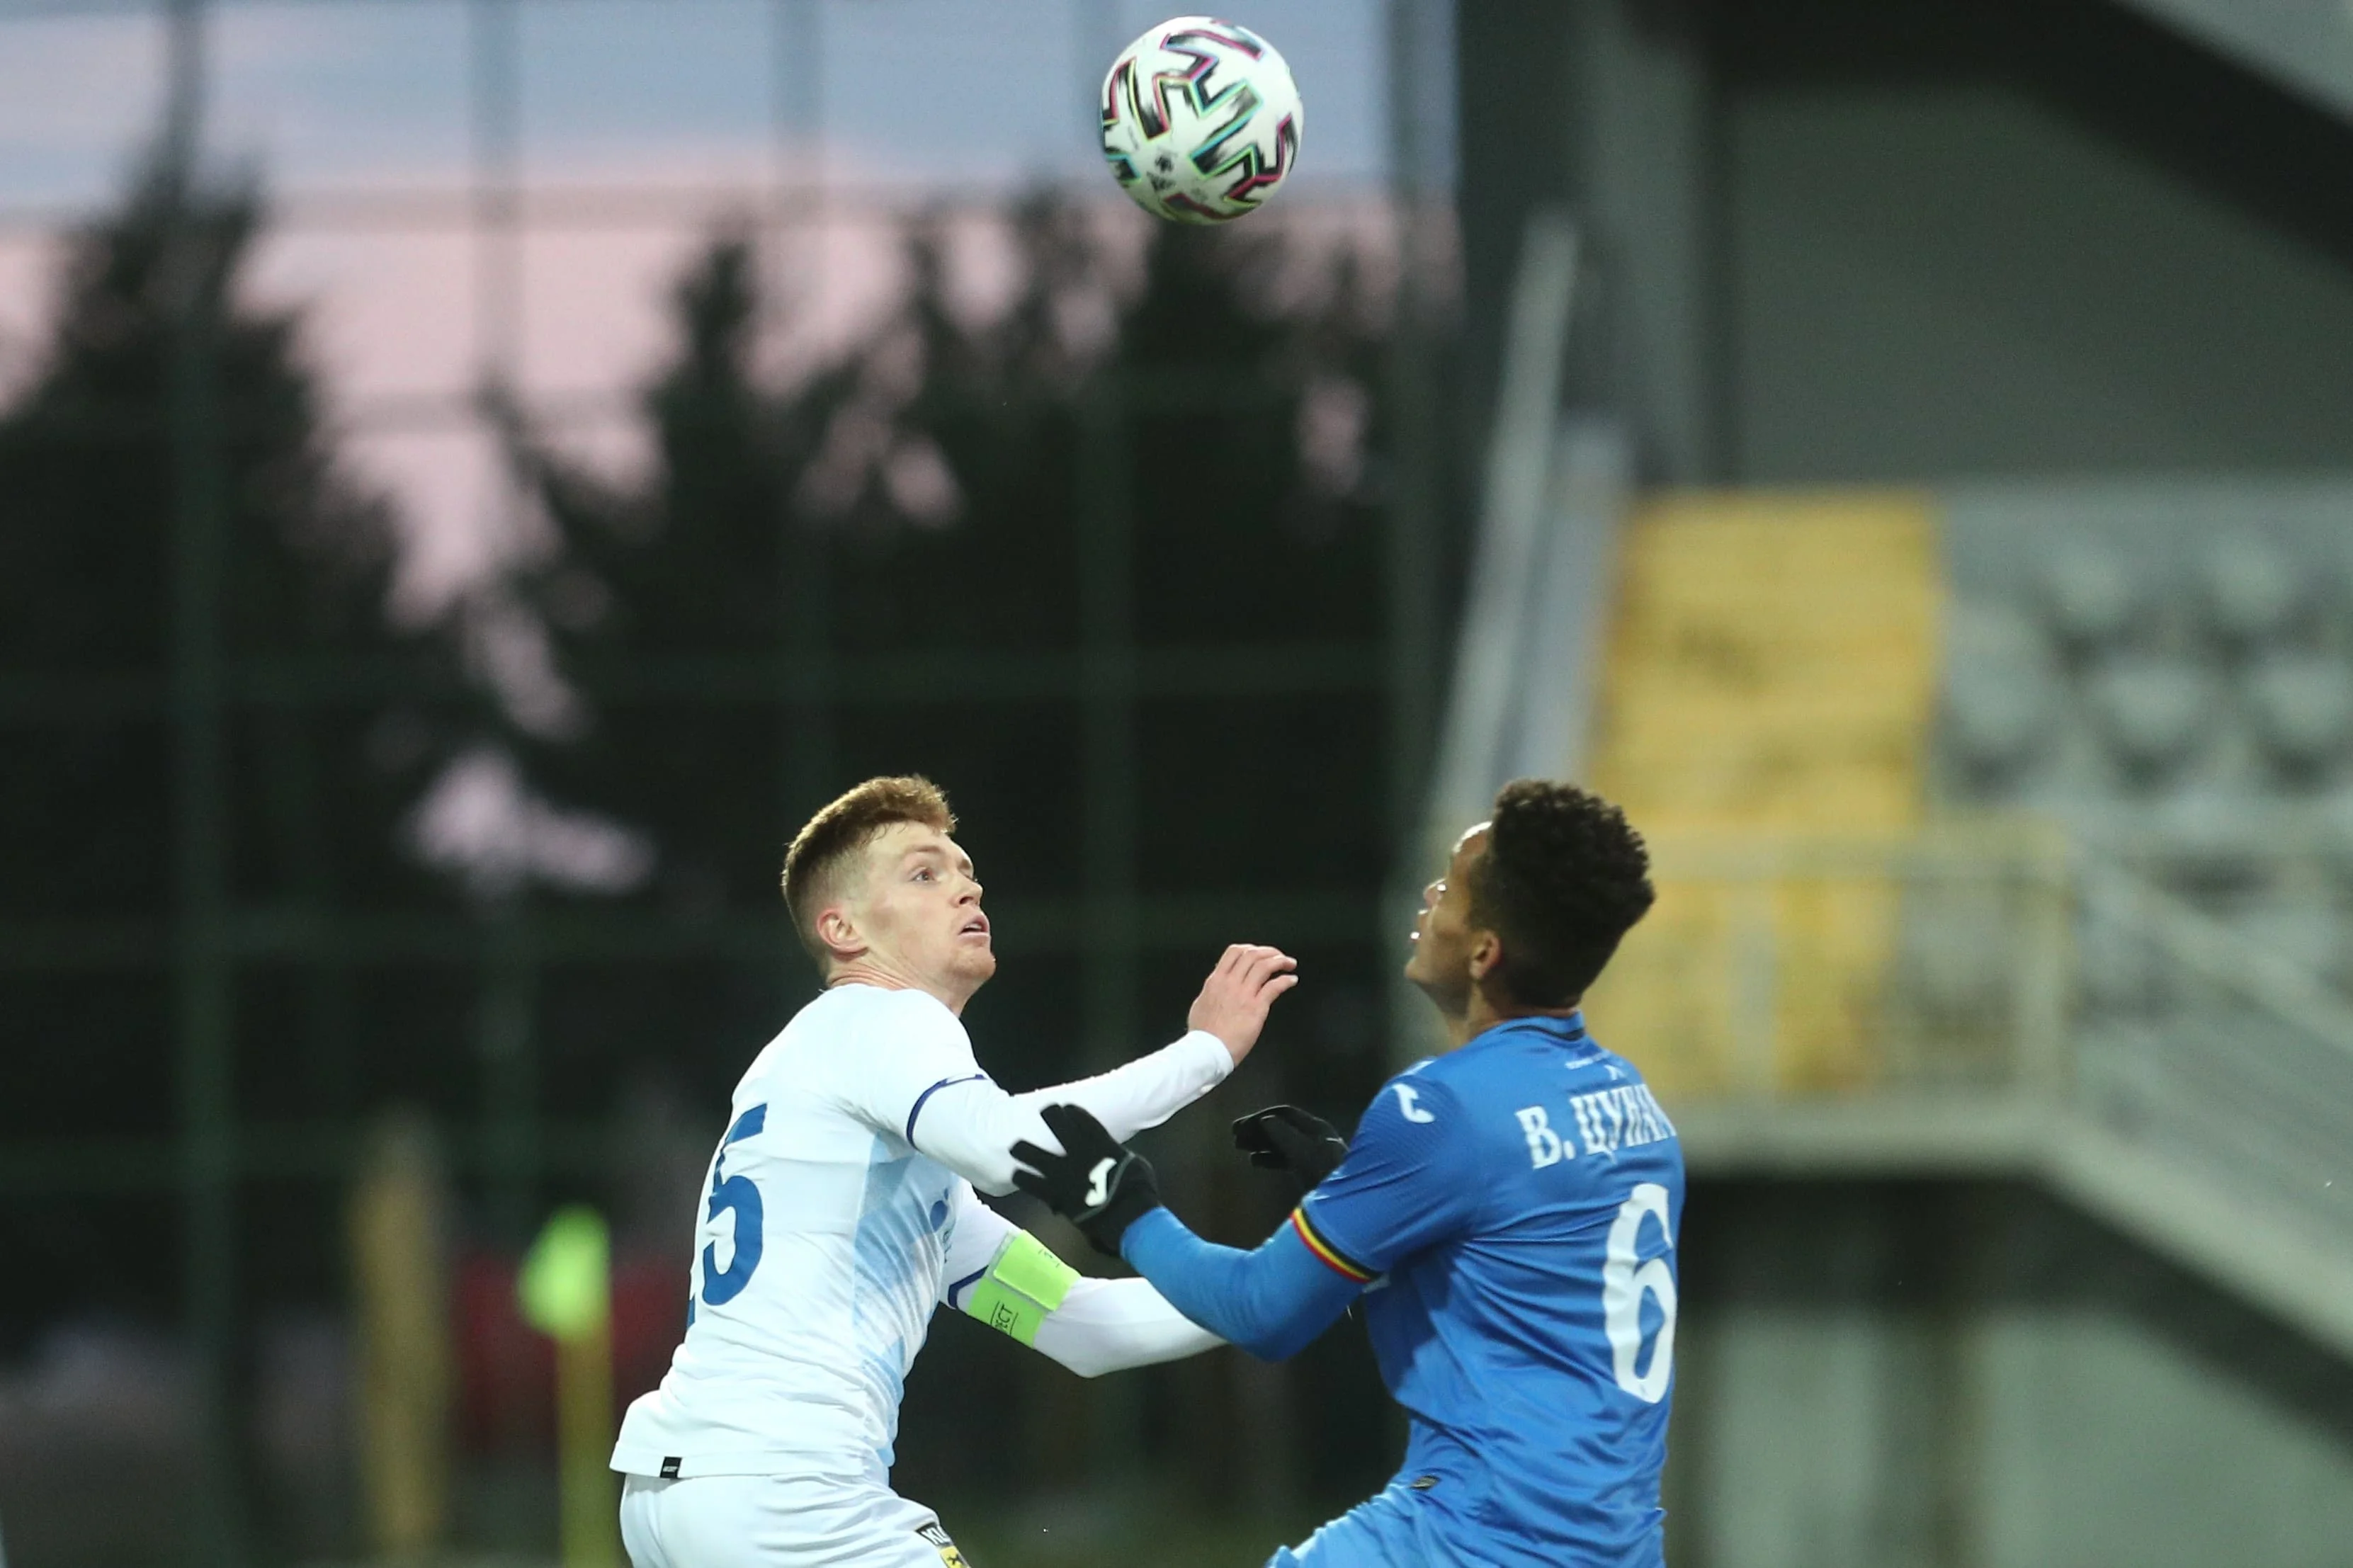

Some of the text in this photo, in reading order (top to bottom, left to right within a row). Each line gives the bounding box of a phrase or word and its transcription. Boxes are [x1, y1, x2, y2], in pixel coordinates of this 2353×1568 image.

[686, 1103, 768, 1326] 5
[1514, 1105, 1577, 1171] В.
[1602, 1183, 1677, 1404] 6
